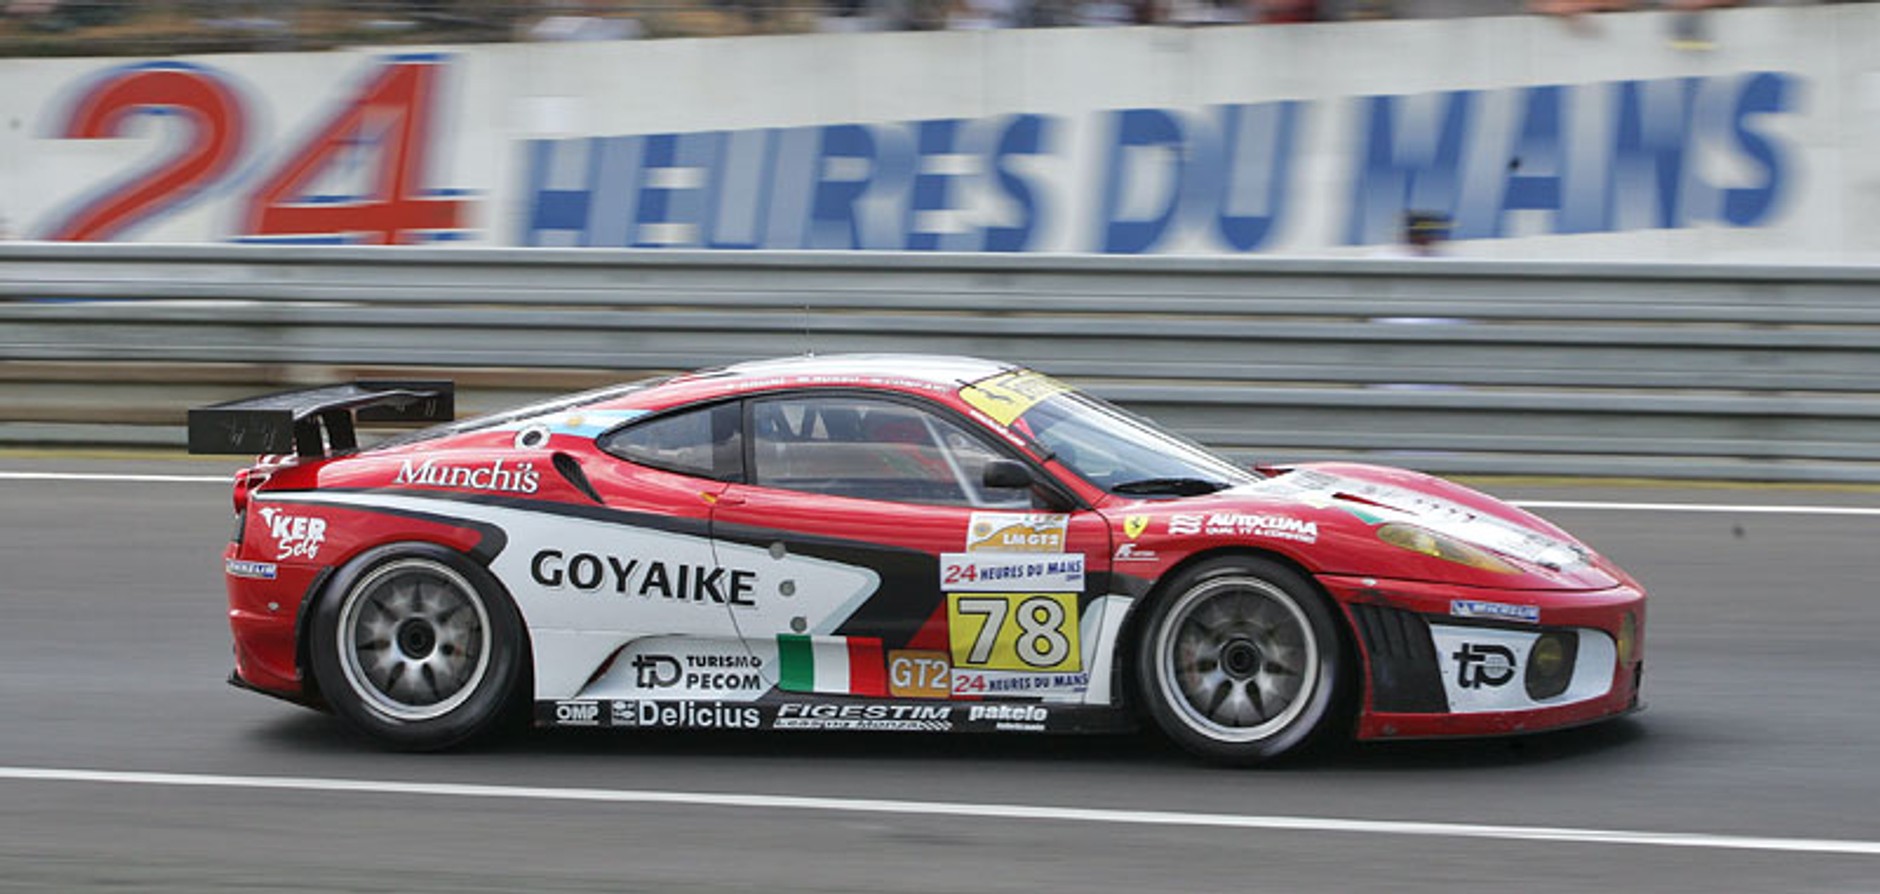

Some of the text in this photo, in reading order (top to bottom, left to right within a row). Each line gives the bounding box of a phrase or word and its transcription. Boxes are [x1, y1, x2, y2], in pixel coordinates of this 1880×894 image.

[38, 52, 1805, 254] 24 HEURES DU MANS
[271, 515, 326, 542] KER
[530, 549, 757, 606] GOYAIKE
[944, 560, 1082, 584] 24 HEURES DU MANS
[956, 596, 1071, 667] 78
[686, 656, 762, 668] TURISMO
[889, 659, 948, 689] GT2
[686, 673, 761, 690] PECOM
[954, 673, 1089, 693] 24 HEURES DU MANS
[556, 705, 598, 719] OMP
[638, 700, 760, 727] Delicius
[778, 703, 952, 720] FIGESTIM
